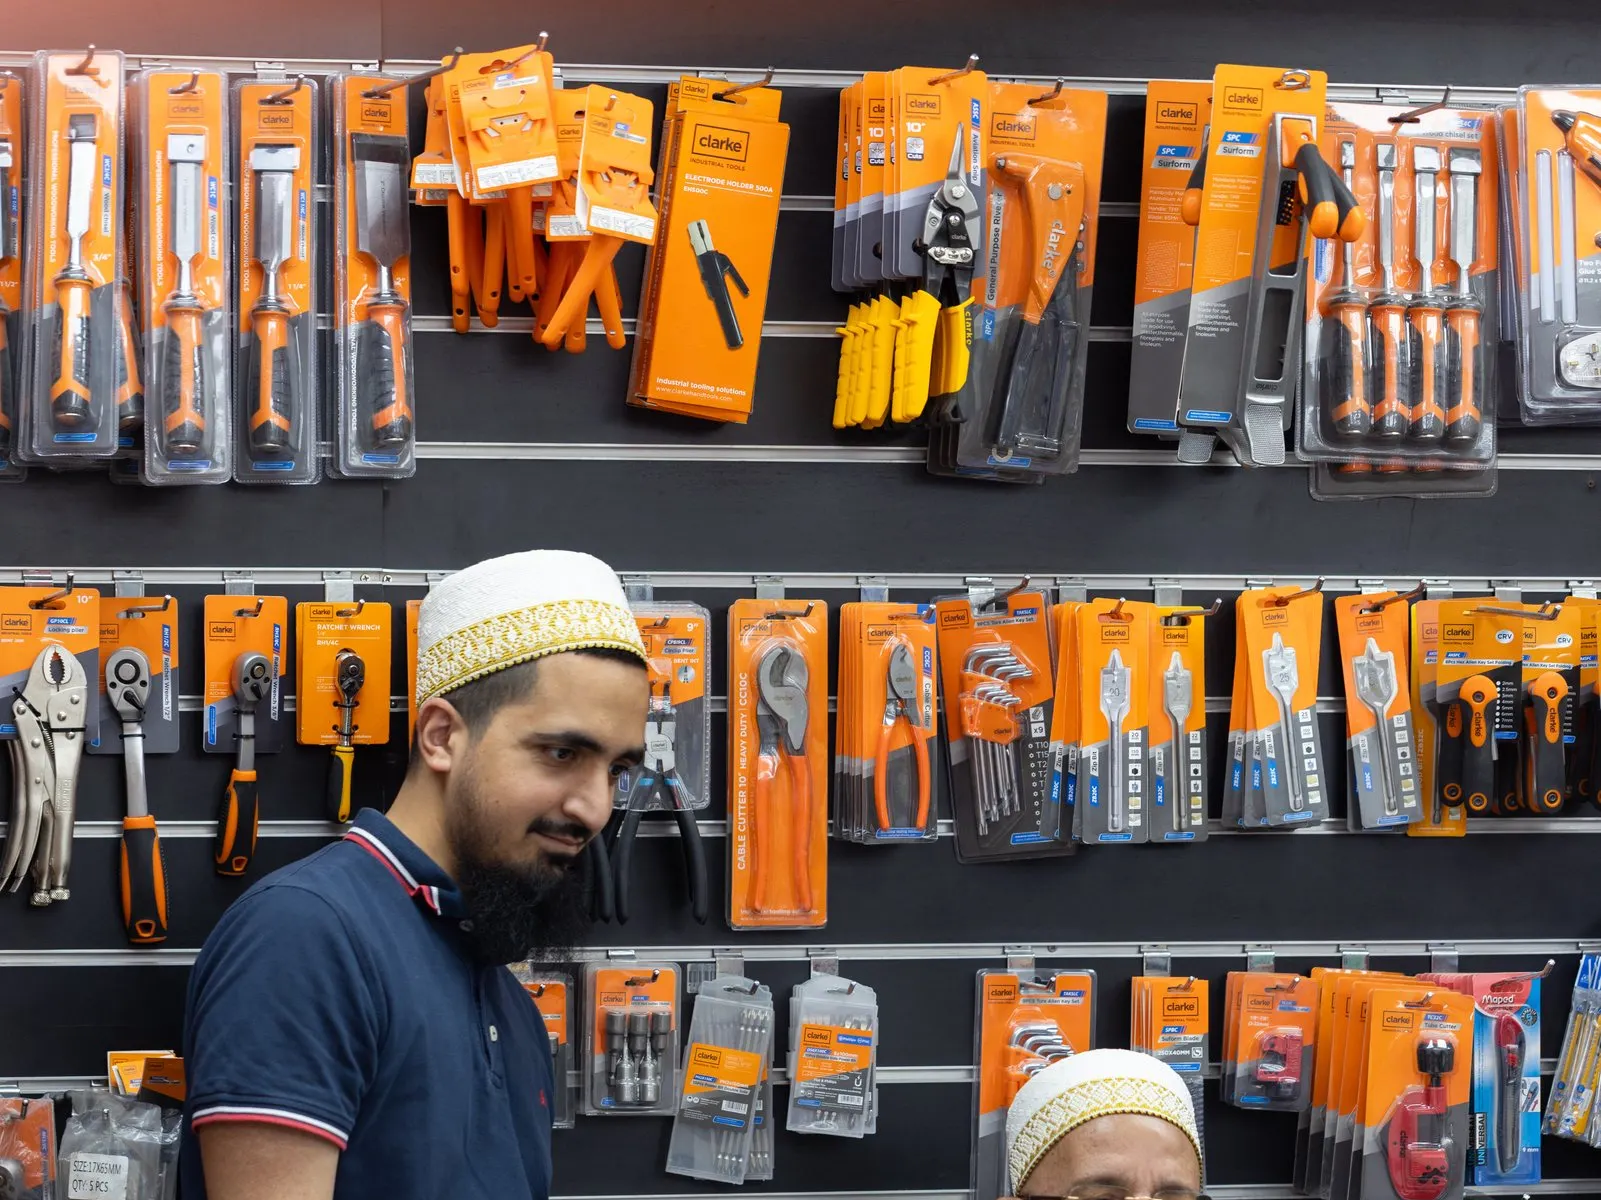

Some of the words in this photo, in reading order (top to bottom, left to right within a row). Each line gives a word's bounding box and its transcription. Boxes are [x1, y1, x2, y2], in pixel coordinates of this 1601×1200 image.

[683, 85, 705, 95] clarke
[909, 100, 937, 110] clarke
[1227, 93, 1259, 105] clarke
[170, 104, 201, 114] clarke
[363, 106, 389, 118] clarke
[1160, 108, 1193, 119] clarke
[262, 113, 291, 125] clarke
[996, 120, 1032, 134] clarke
[1227, 133, 1242, 142] SPC
[1445, 130, 1465, 138] chisel
[1466, 131, 1479, 139] set
[698, 133, 743, 154] clarke
[972, 133, 980, 164] Aviation
[1161, 147, 1176, 155] SPC
[1223, 146, 1255, 156] Surform
[689, 157, 725, 169] INDUSTRIAL
[726, 164, 746, 172] TOOLS
[1158, 159, 1191, 169] Surform
[971, 164, 980, 182] Snip
[243, 160, 251, 211] PROFESSIONAL
[685, 173, 726, 186] ELECTRODE
[726, 180, 755, 190] HOLDER
[755, 184, 774, 194] 500A
[49, 239, 57, 263] TOOLS
[990, 227, 1002, 265] Purpose
[156, 262, 164, 287] TOOLS
[1578, 268, 1595, 276] Glue
[987, 266, 997, 301] General
[349, 299, 358, 351] PROFESSIONAL
[965, 311, 973, 345] clarke
[985, 318, 993, 336] RPC
[350, 351, 358, 407] WOODWORKING
[656, 376, 689, 389] Industrial
[689, 382, 715, 393] tooling
[716, 385, 746, 397] solutions
[350, 407, 358, 431] TOOLS
[76, 595, 93, 604] 10"
[312, 608, 331, 616] clarke
[1264, 613, 1285, 621] clarke
[4, 618, 29, 627] clarke
[944, 614, 966, 623] clarke
[1359, 619, 1380, 628] clarke
[48, 625, 71, 634] Locking
[316, 623, 349, 631] RATCHET
[686, 622, 699, 632] 9"
[870, 628, 895, 638] clarke
[1446, 628, 1471, 637] clarke
[163, 627, 171, 648] RH1/2C
[1165, 631, 1186, 639] clarke
[1497, 632, 1513, 640] CRV
[272, 656, 280, 680] Ratchet
[1279, 672, 1290, 683] 25
[272, 681, 280, 705] Wrench
[739, 672, 748, 707] CC10C
[924, 682, 932, 704] Cable
[1109, 687, 1120, 697] 20
[163, 706, 171, 719] 1/2"
[924, 704, 932, 728] Cutter
[740, 713, 748, 738] DUTY
[1474, 711, 1483, 737] clarke
[1549, 707, 1557, 733] clarke
[1033, 726, 1044, 734] x9
[739, 740, 747, 770] HEAVY
[1036, 751, 1049, 759] T15
[1235, 746, 1243, 757] Zip
[1055, 757, 1063, 768] Zip
[737, 772, 747, 789] 10"
[738, 790, 746, 833] CUTTER
[737, 835, 746, 871] CABLE
[991, 987, 1013, 996] clarke
[603, 995, 623, 1003] clarke
[1250, 998, 1271, 1007] clarke
[1481, 993, 1515, 1005] Maped
[1166, 1001, 1195, 1012] clarke
[1386, 1015, 1410, 1025] clarke
[807, 1032, 829, 1040] clarke
[697, 1053, 718, 1061] clarke
[1477, 1113, 1485, 1165] UNIVERSAL
[73, 1160, 122, 1175] SIZE:17X65MM
[73, 1180, 89, 1192] QTY:
[90, 1180, 96, 1191] 5
[97, 1181, 114, 1193] PCS
